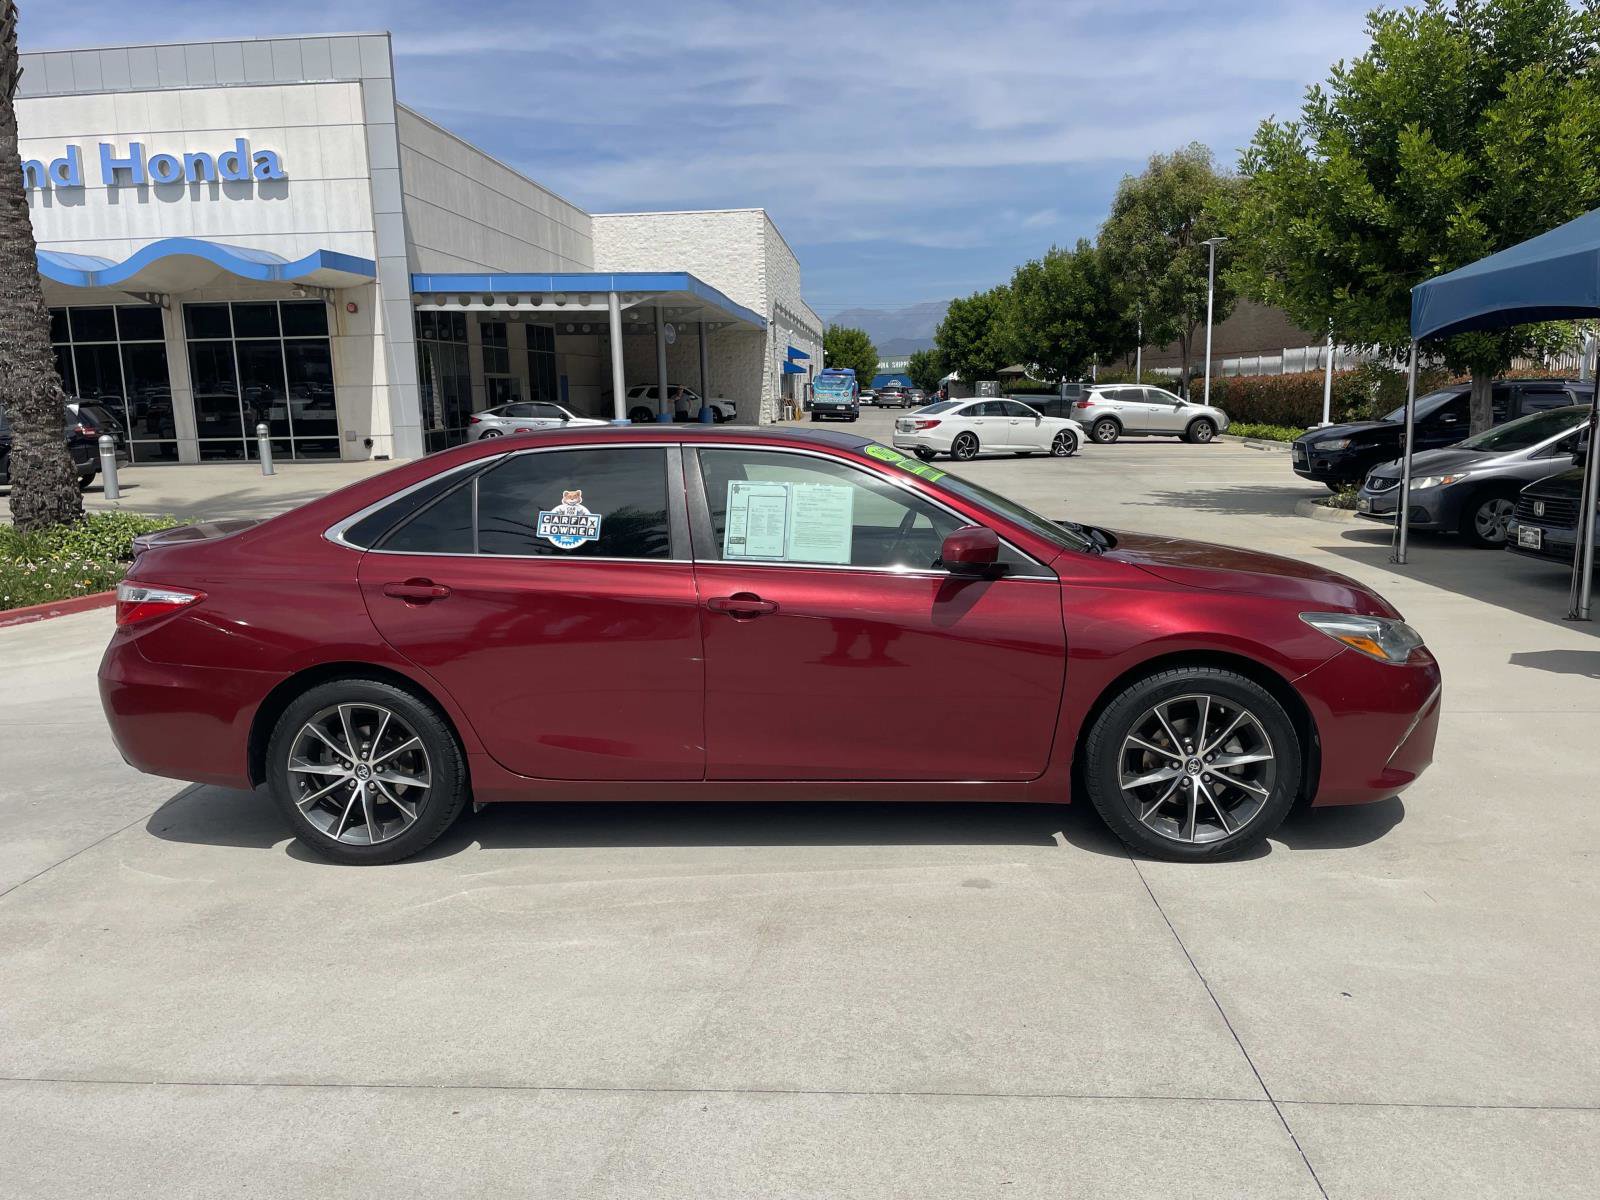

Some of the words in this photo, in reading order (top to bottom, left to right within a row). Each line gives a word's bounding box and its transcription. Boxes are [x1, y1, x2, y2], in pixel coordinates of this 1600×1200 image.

[99, 137, 288, 186] Honda
[543, 515, 596, 527] CARFAX
[551, 526, 595, 536] OWNER
